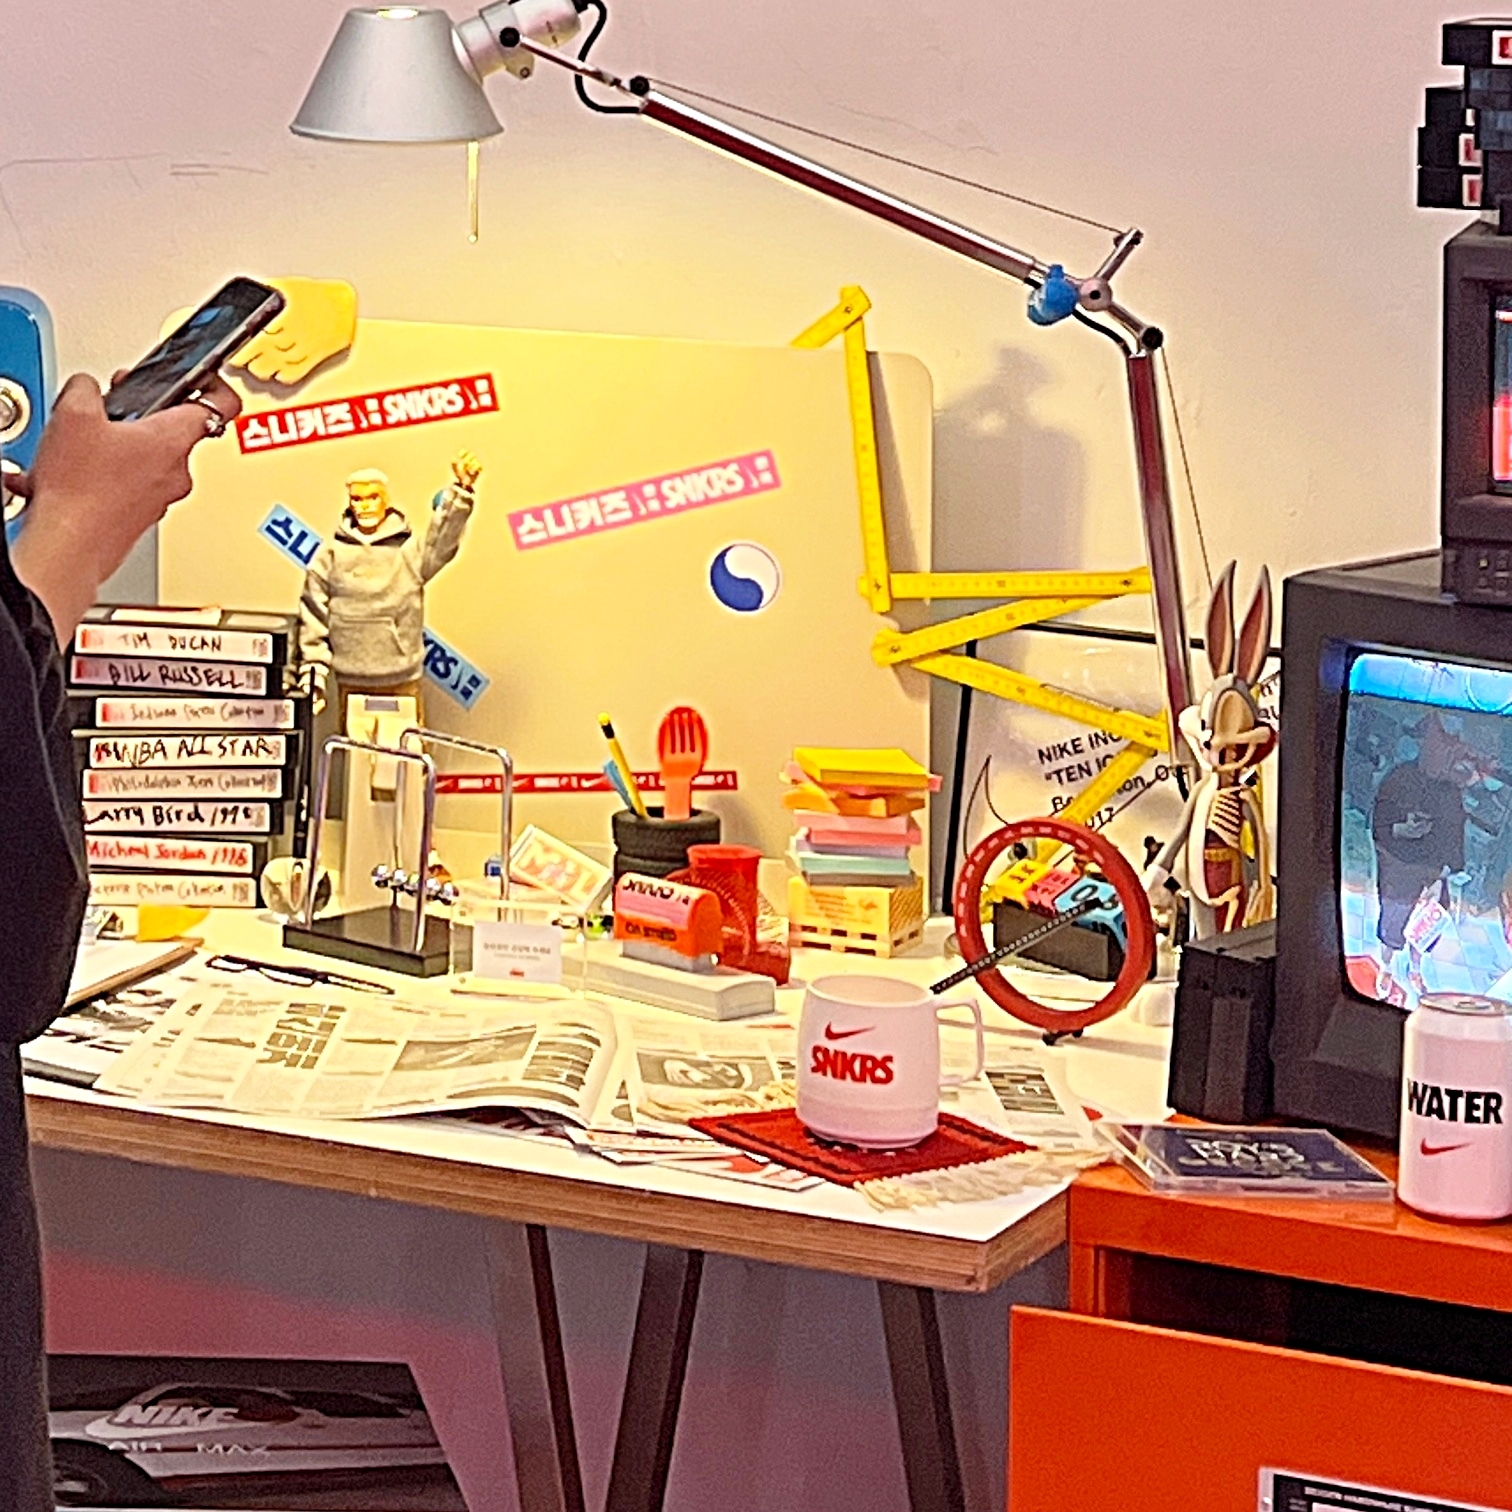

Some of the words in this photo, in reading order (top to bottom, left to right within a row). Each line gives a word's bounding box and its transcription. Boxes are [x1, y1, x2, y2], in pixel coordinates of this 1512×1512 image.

[242, 401, 355, 449] 스니커즈
[382, 383, 465, 425] SNKRS
[517, 490, 633, 544] 스니커즈
[264, 516, 321, 566] 스니
[1038, 737, 1085, 765] NIKE
[152, 804, 206, 826] Bird
[811, 1044, 894, 1085] SNKRS
[1406, 1077, 1503, 1125] WATER
[110, 1405, 240, 1427] NIKE
